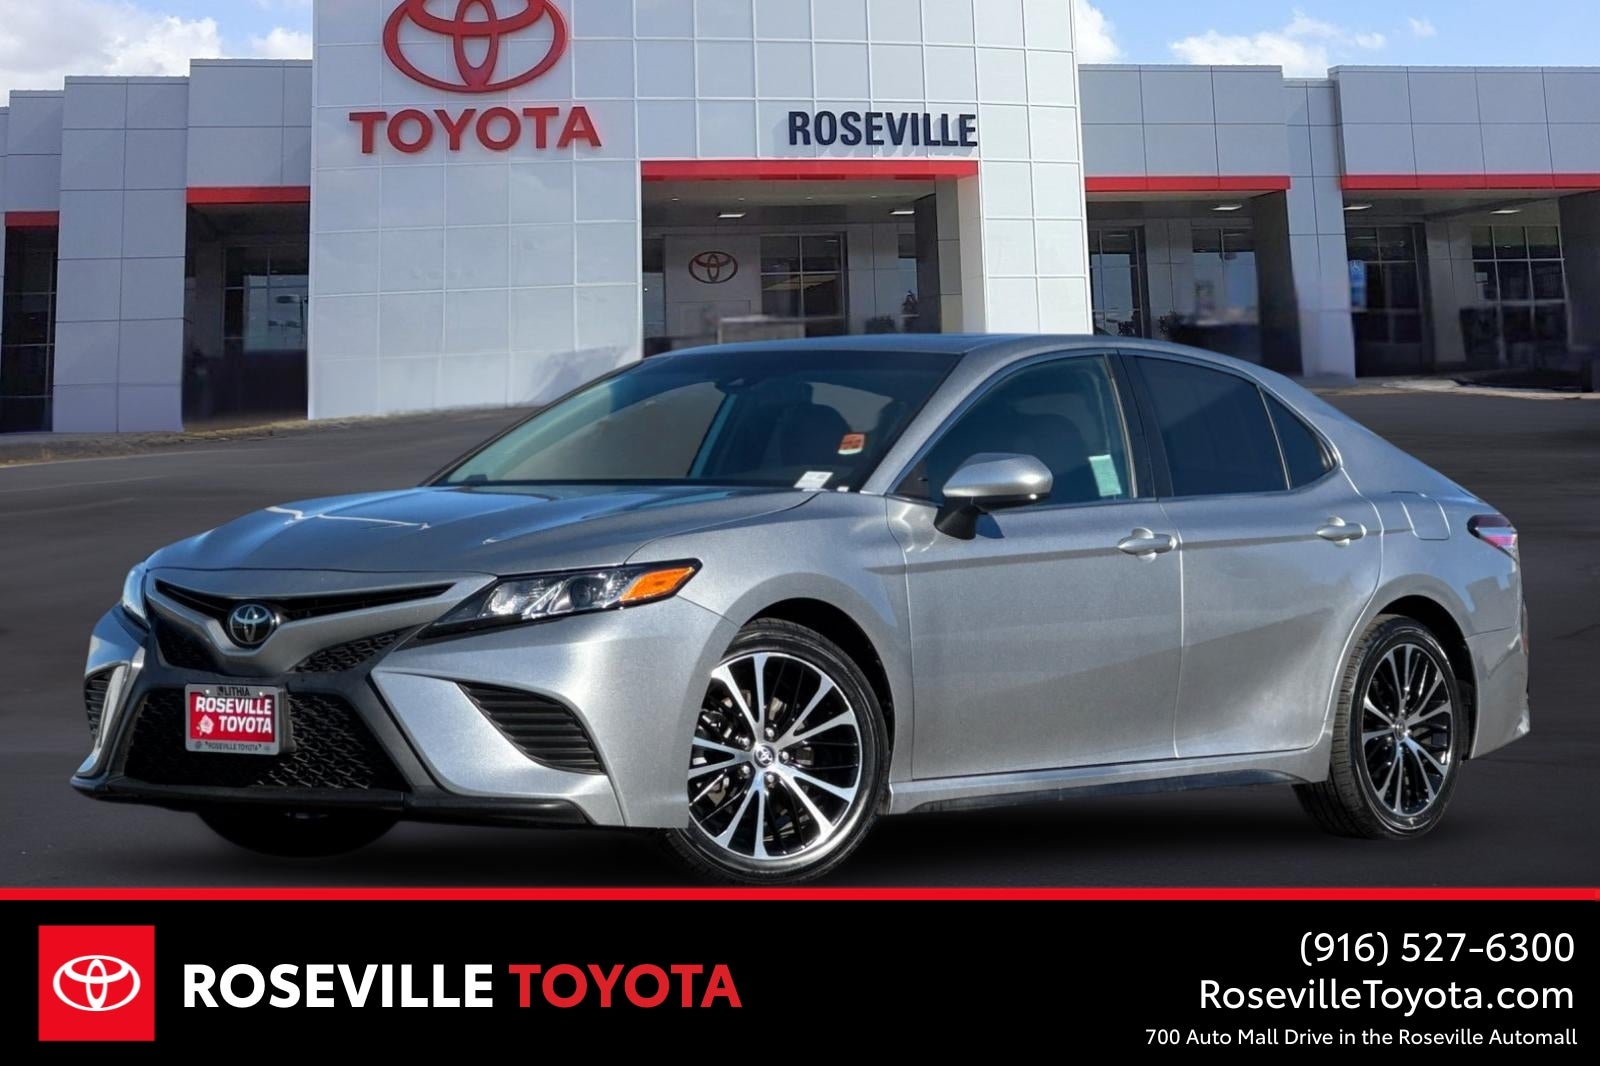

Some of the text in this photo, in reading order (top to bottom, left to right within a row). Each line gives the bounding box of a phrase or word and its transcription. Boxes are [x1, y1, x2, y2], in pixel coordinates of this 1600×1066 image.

[350, 106, 602, 154] TOYOTA
[788, 111, 978, 147] ROSEVILLE
[224, 686, 250, 697] LITHIA
[195, 696, 272, 715] ROSEVILLE
[218, 715, 272, 734] TOYOTA
